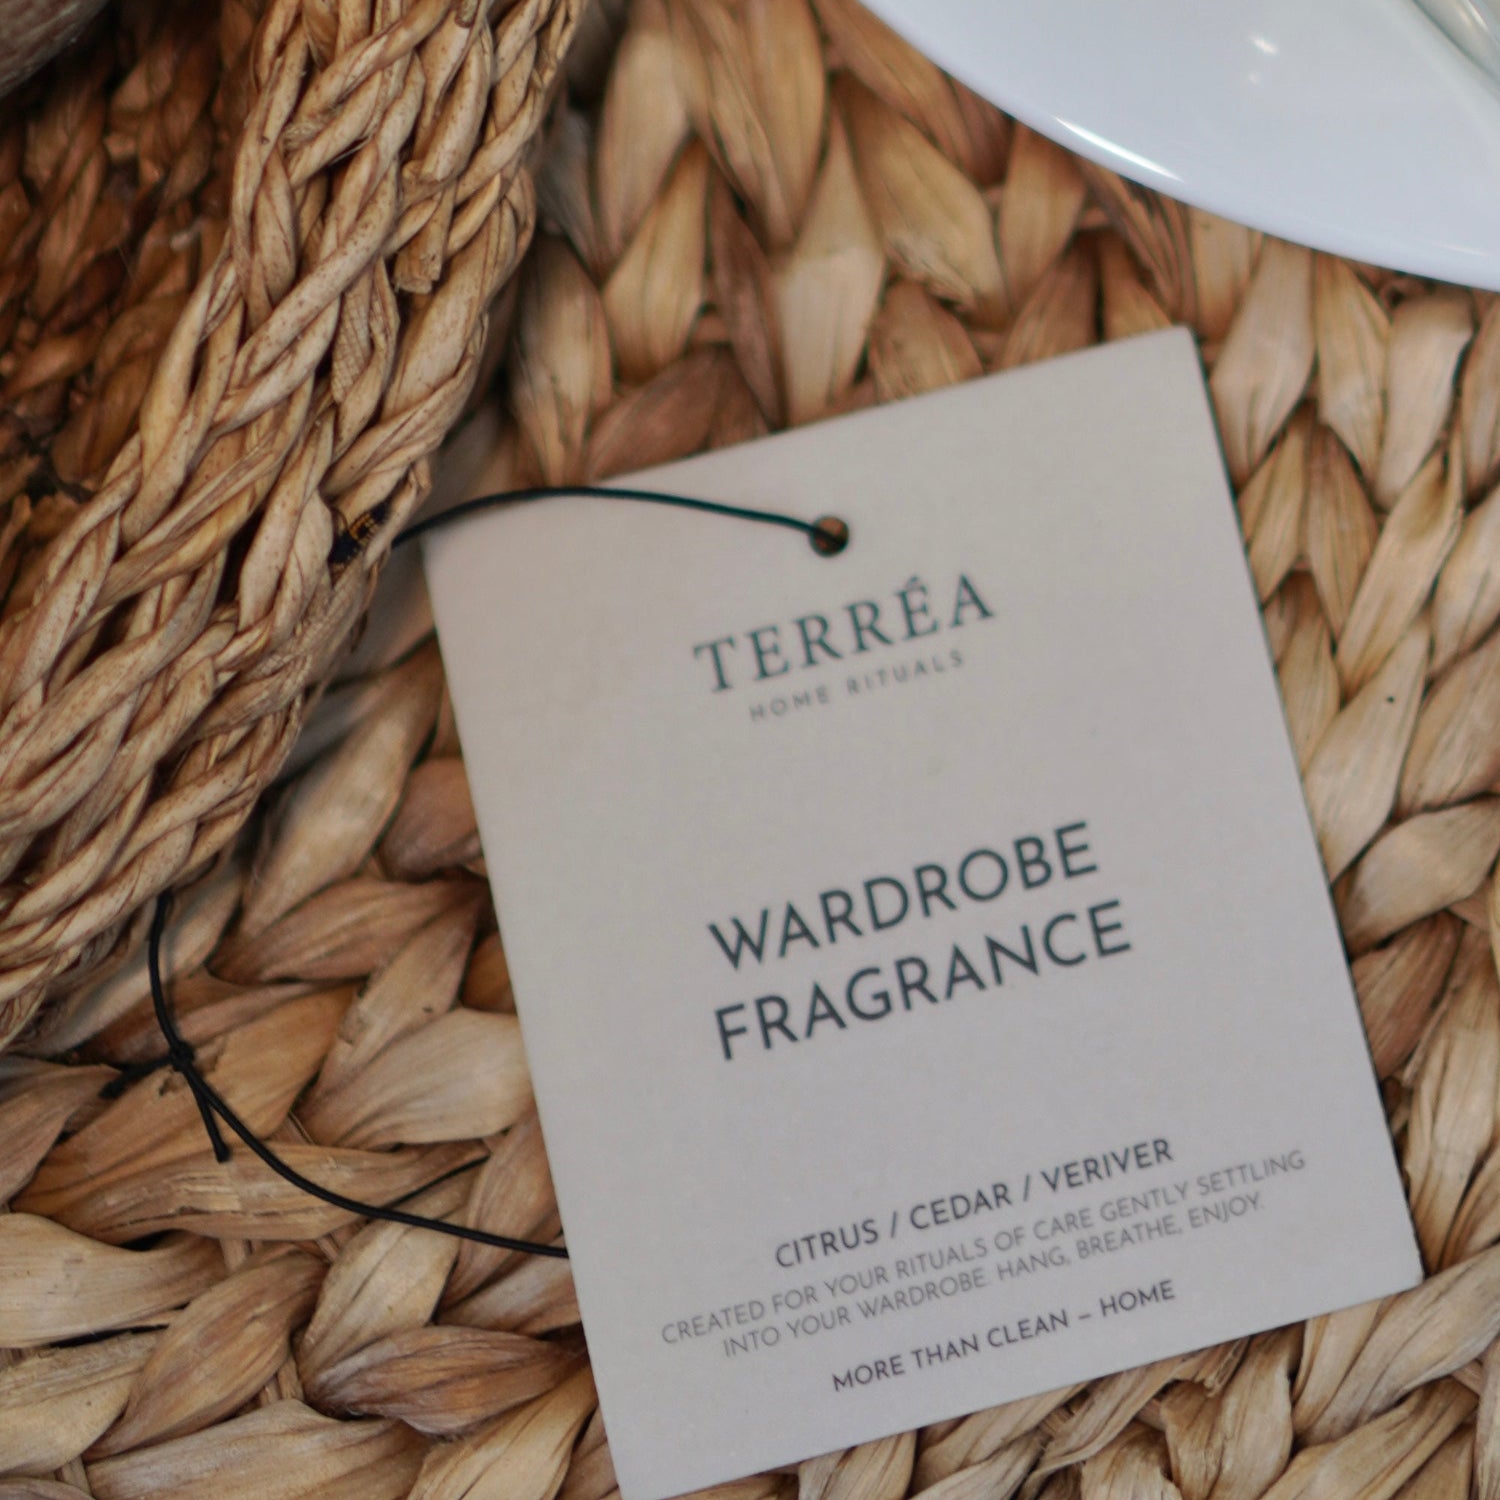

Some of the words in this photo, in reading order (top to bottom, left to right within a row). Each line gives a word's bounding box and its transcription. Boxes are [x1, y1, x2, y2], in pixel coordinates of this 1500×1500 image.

[692, 573, 995, 693] TERRÉA
[748, 685, 830, 722] HOME
[845, 650, 964, 695] RITUALS
[707, 820, 1098, 971] WARDROBE
[714, 898, 1132, 1061] FRAGRANCE
[661, 1299, 765, 1345] CREATED
[771, 1284, 818, 1315] FOR
[824, 1265, 890, 1299] YOUR
[895, 1236, 989, 1280] RITUALS
[993, 1226, 1026, 1252] OF
[1033, 1207, 1093, 1243] CARE
[1100, 1180, 1189, 1223] GENTLY
[1196, 1149, 1307, 1196] SETTLING
[775, 1218, 880, 1268] CITRUS
[909, 1183, 1013, 1231] CEDAR
[1040, 1137, 1174, 1193] VERIVER
[723, 1325, 780, 1359] INTO
[786, 1305, 852, 1337] YOUR
[832, 1354, 906, 1393] MORE
[911, 1333, 980, 1370] THAN
[987, 1309, 1069, 1349] CLEAN
[1100, 1279, 1176, 1318] HOME
